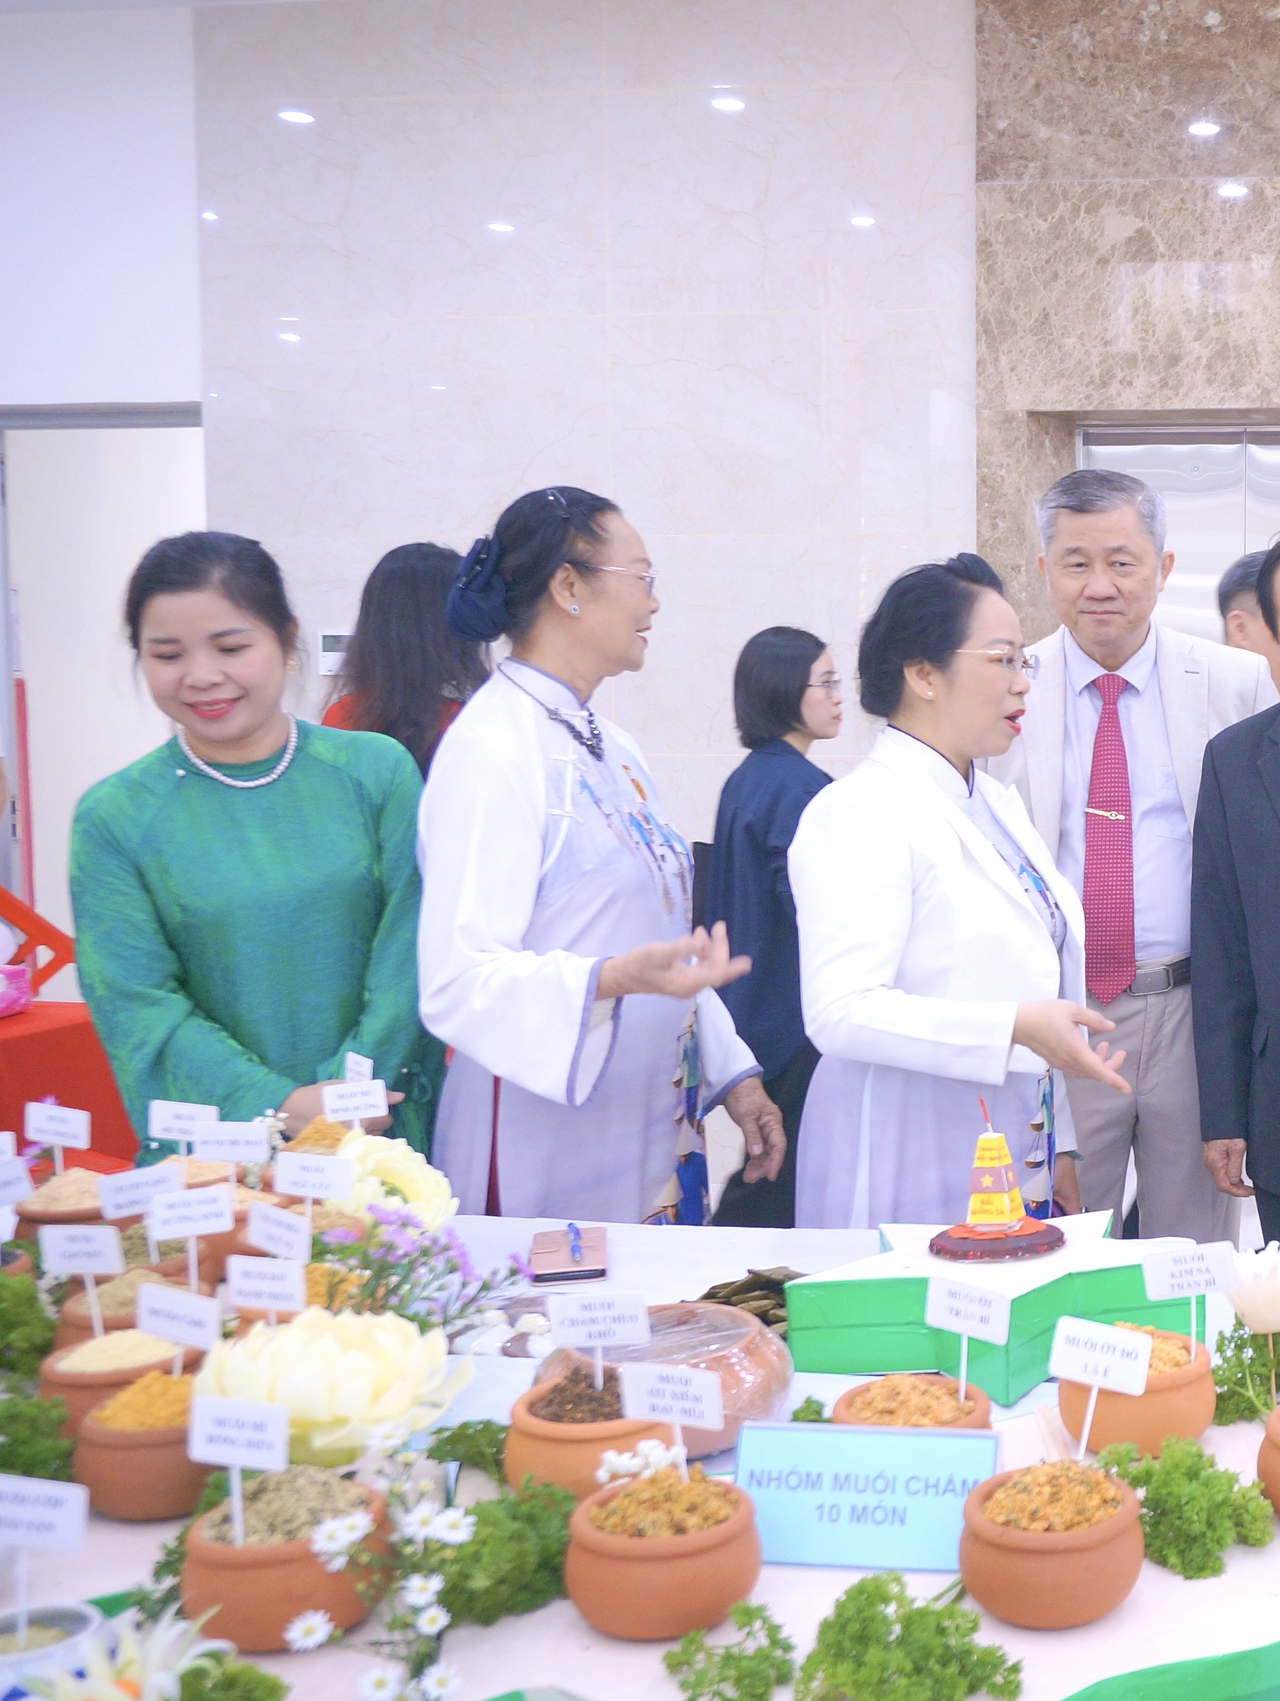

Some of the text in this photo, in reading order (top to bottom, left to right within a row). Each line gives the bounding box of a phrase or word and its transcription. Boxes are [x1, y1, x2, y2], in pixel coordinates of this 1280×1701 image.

[1064, 1333, 1098, 1353] MUỐI
[749, 1465, 824, 1493] NHÓM
[831, 1470, 897, 1496] MUỐI
[815, 1499, 908, 1527] 10 MÓN
